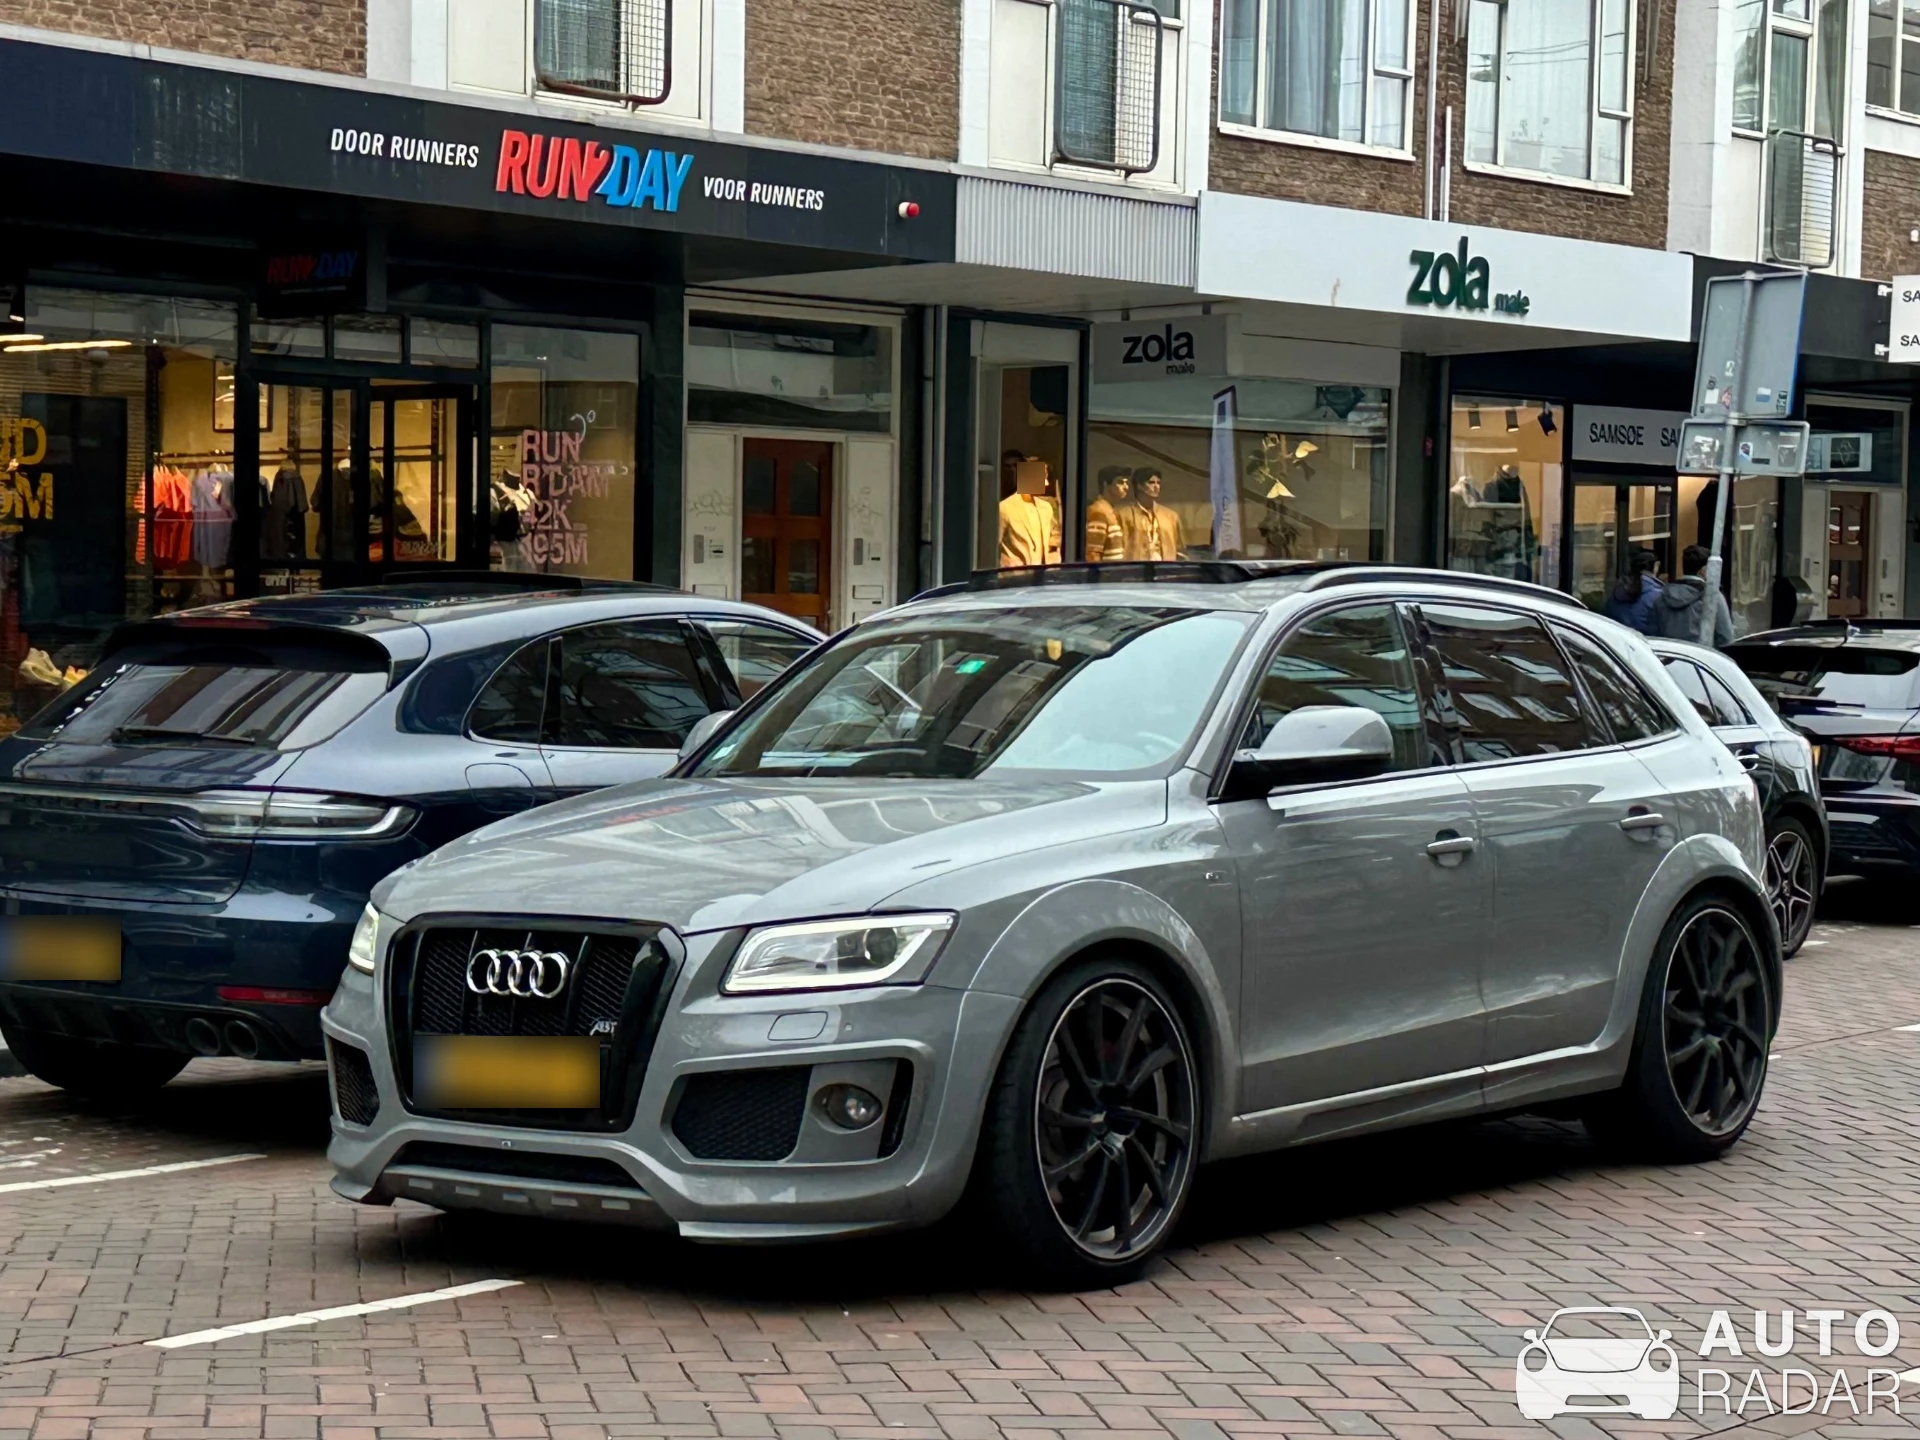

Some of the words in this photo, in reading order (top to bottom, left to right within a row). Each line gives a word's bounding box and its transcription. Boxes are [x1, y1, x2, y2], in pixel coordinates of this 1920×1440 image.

[331, 129, 384, 156] DOOR
[390, 136, 480, 168] RUNNERS
[703, 176, 747, 202] VOOR
[750, 182, 825, 212] RUNNERS
[1406, 236, 1489, 309] zola
[1494, 289, 1530, 315] male
[1122, 323, 1195, 364] zola
[522, 429, 580, 463] RUN
[1660, 427, 1681, 447] SA
